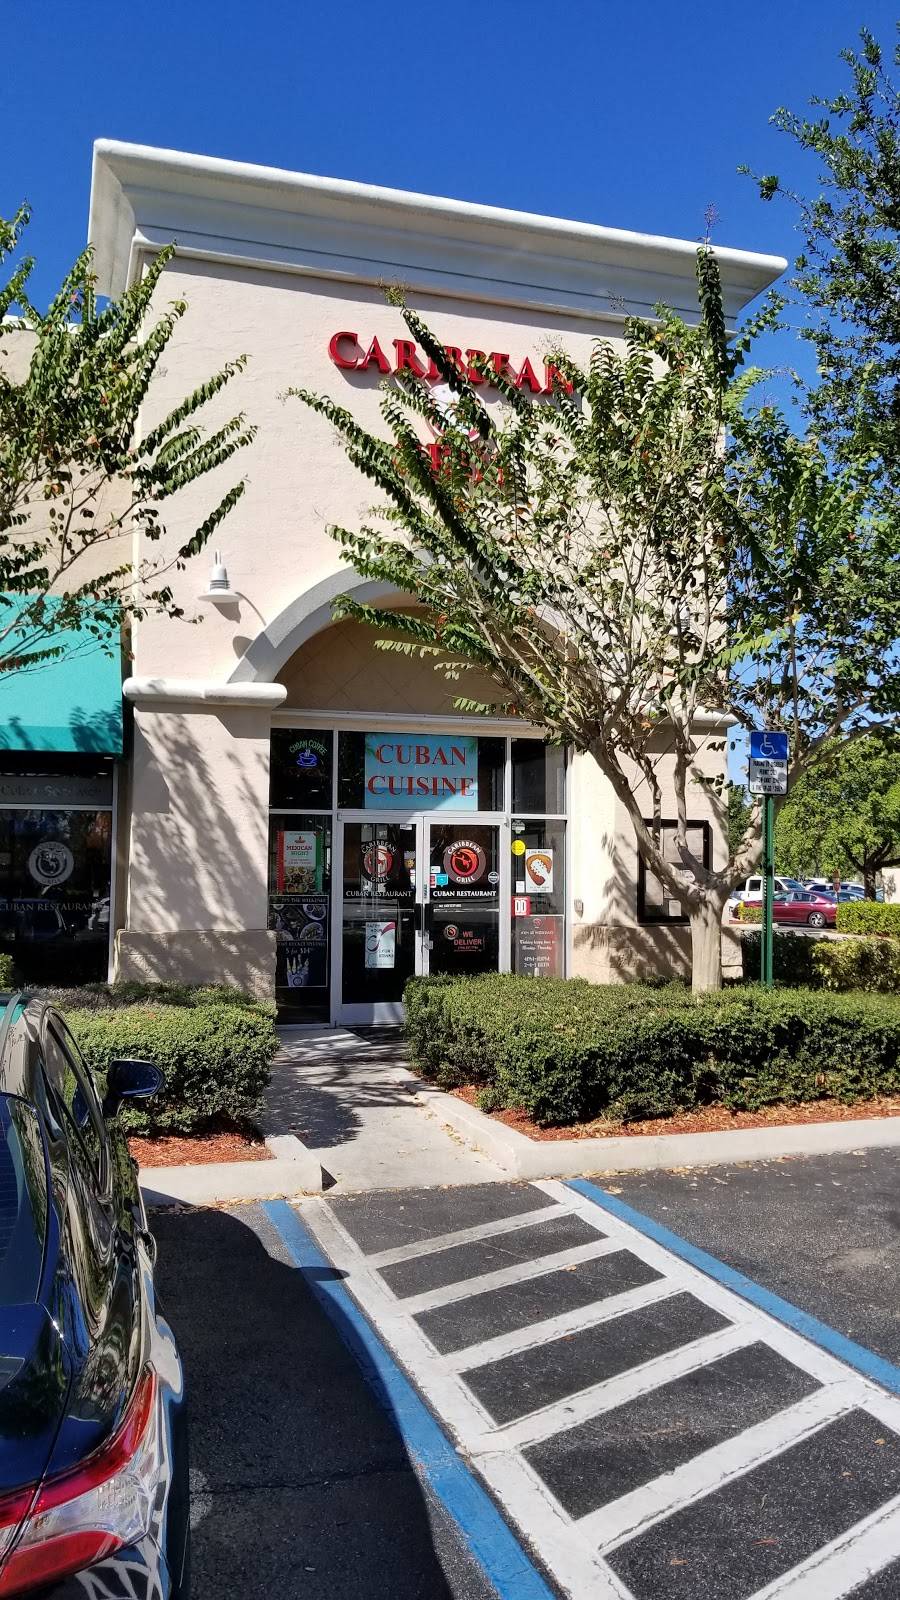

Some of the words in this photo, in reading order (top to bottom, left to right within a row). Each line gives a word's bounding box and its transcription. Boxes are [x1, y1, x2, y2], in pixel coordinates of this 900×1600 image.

[376, 744, 466, 766] CUBAN
[367, 775, 475, 797] CUISINE
[361, 840, 397, 855] CARIBBEAN
[447, 841, 482, 854] CARIBBEAN
[37, 902, 98, 911] RESTAURAN
[462, 930, 474, 938] WE
[453, 938, 482, 946] DELIVER
